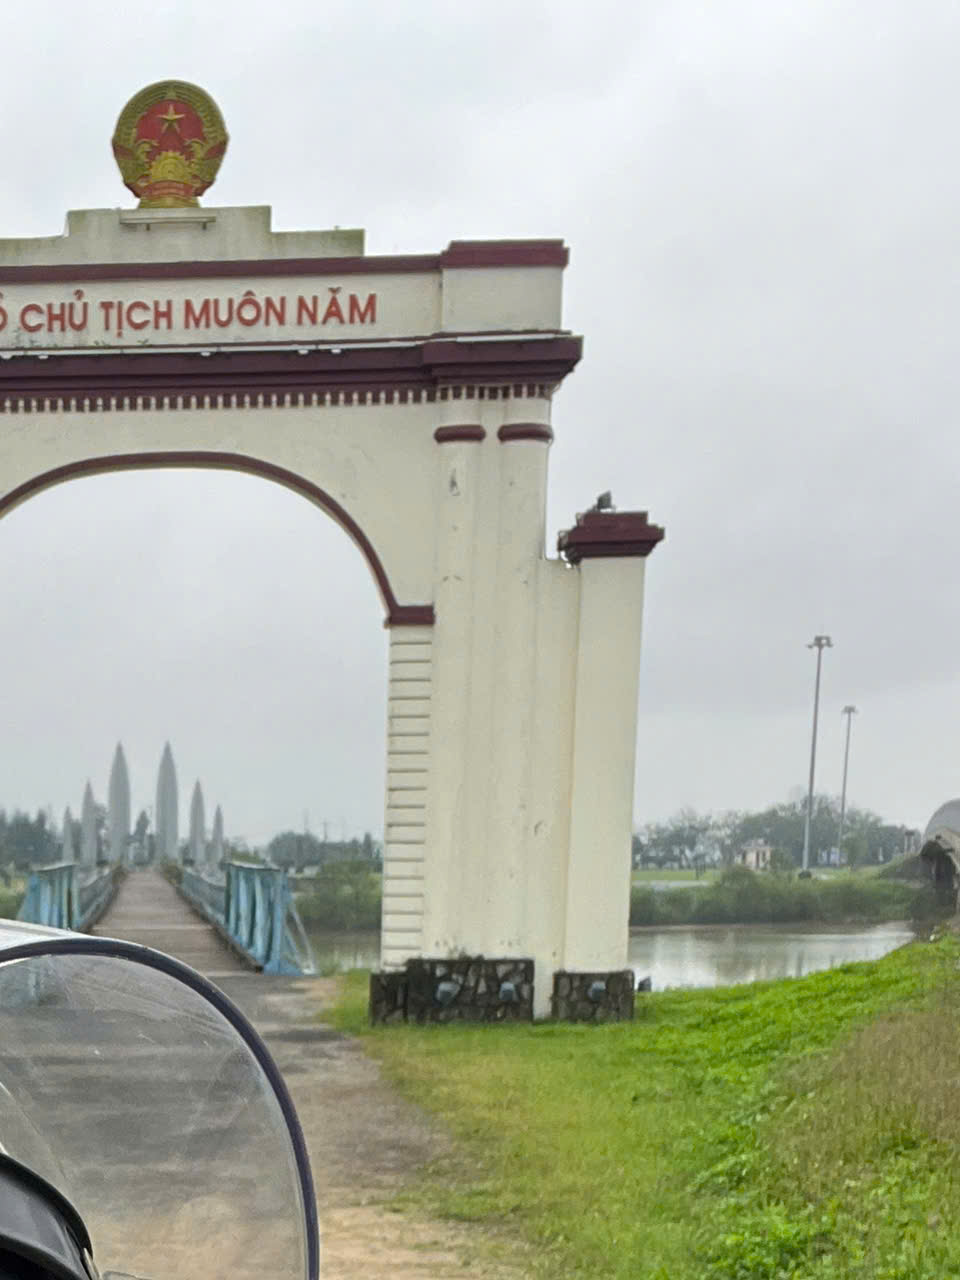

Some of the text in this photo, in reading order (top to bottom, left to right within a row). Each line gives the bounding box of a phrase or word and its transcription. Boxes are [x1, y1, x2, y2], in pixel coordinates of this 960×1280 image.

[19, 288, 89, 333] CHỦ
[99, 299, 174, 338] TỊCH
[183, 290, 287, 329] MUÔN
[296, 286, 378, 327] NĂM
